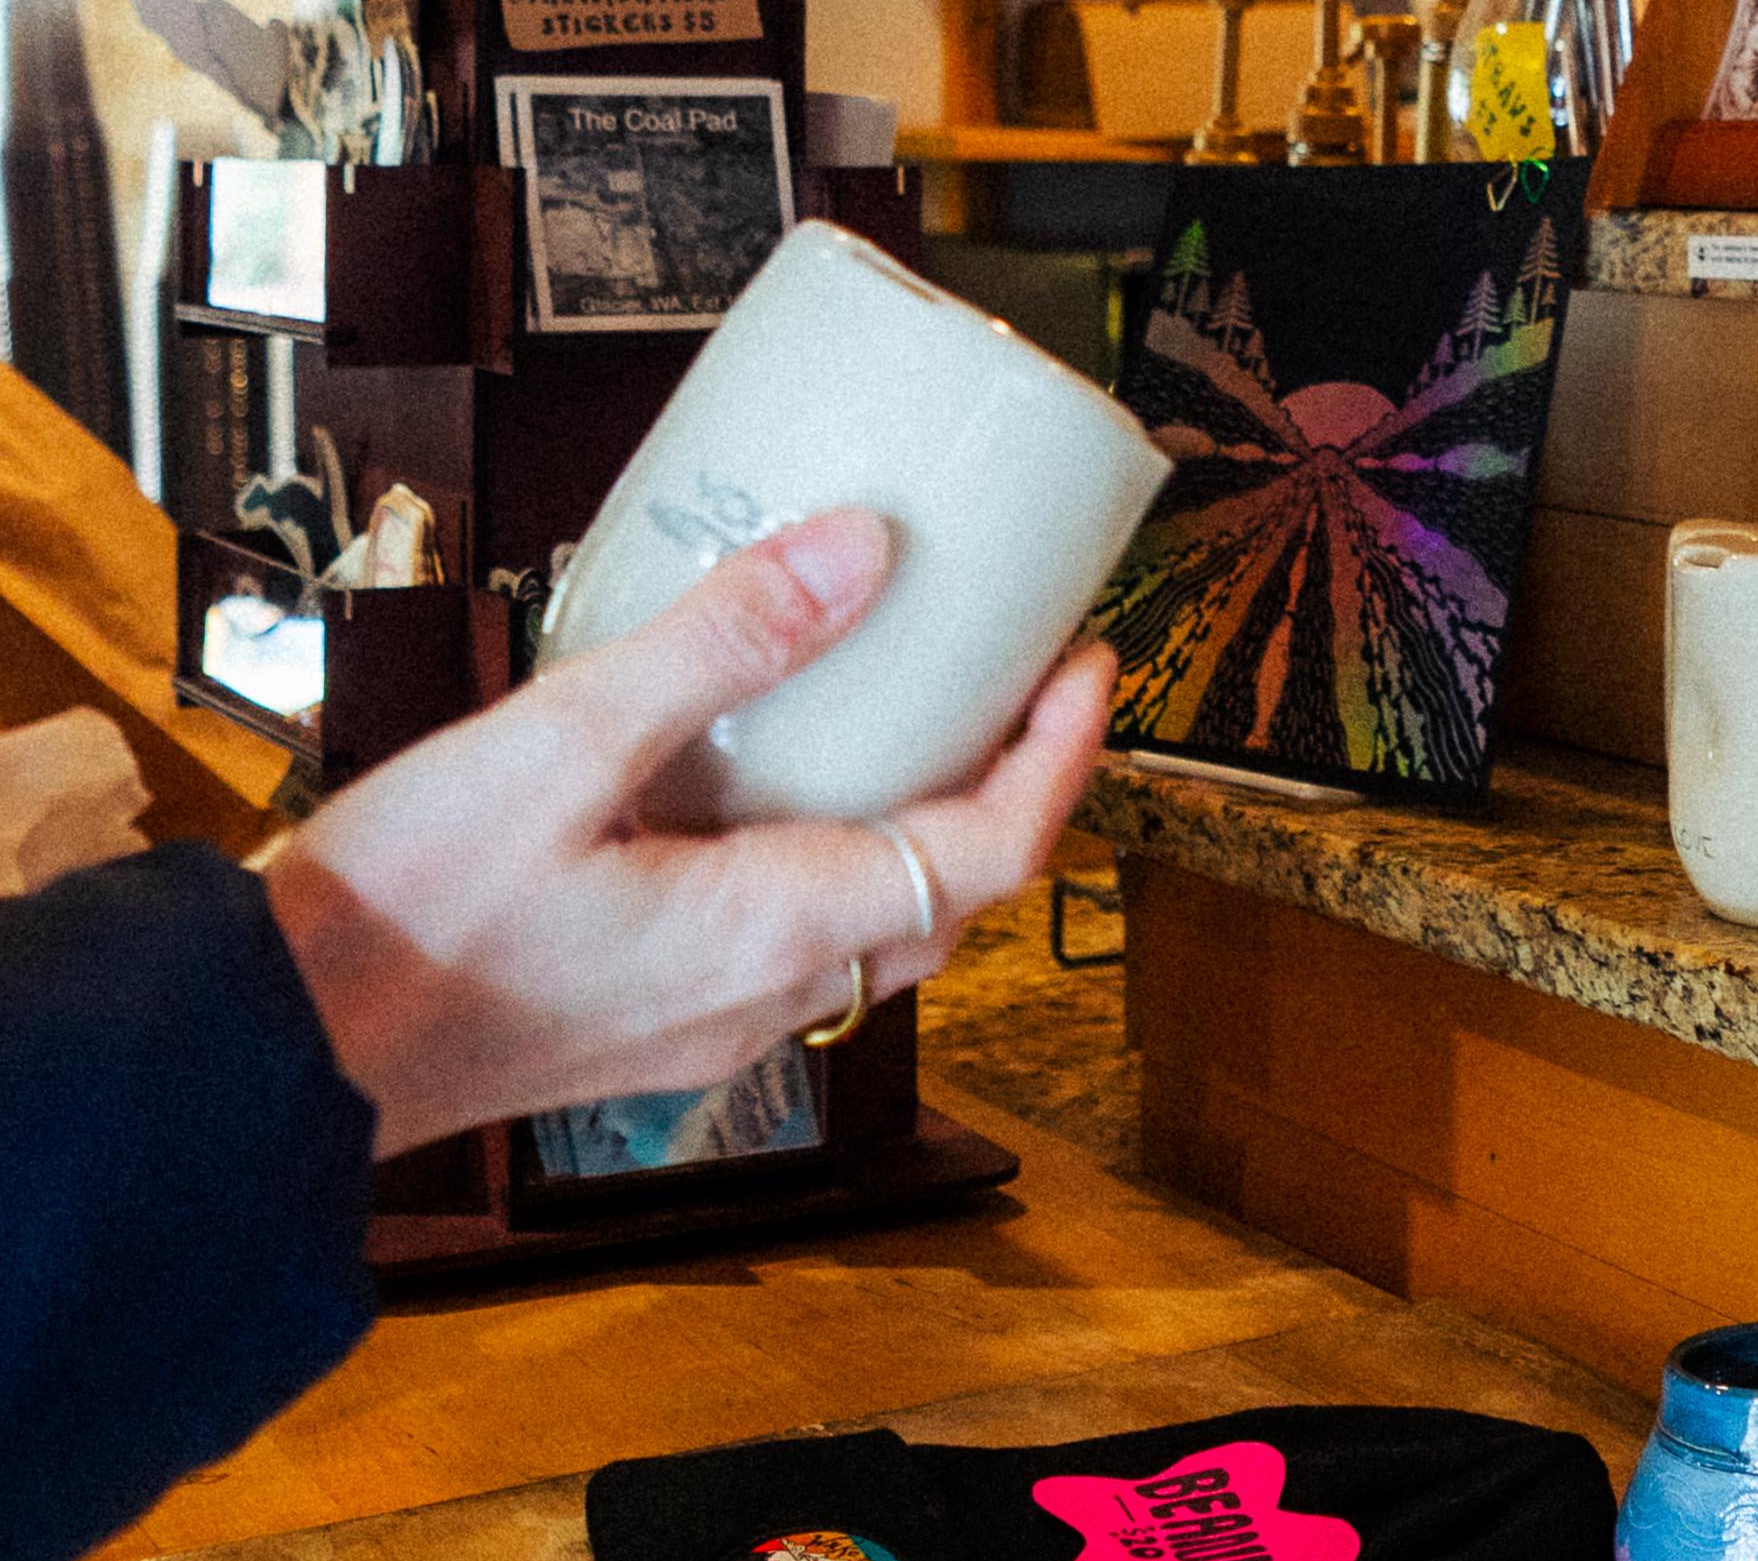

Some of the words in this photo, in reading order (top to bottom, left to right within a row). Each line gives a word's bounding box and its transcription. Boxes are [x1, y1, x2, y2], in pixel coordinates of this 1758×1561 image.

[542, 11, 673, 36] STICKERS
[567, 107, 617, 131] The
[624, 107, 682, 131] Coal
[689, 108, 738, 131] Pad
